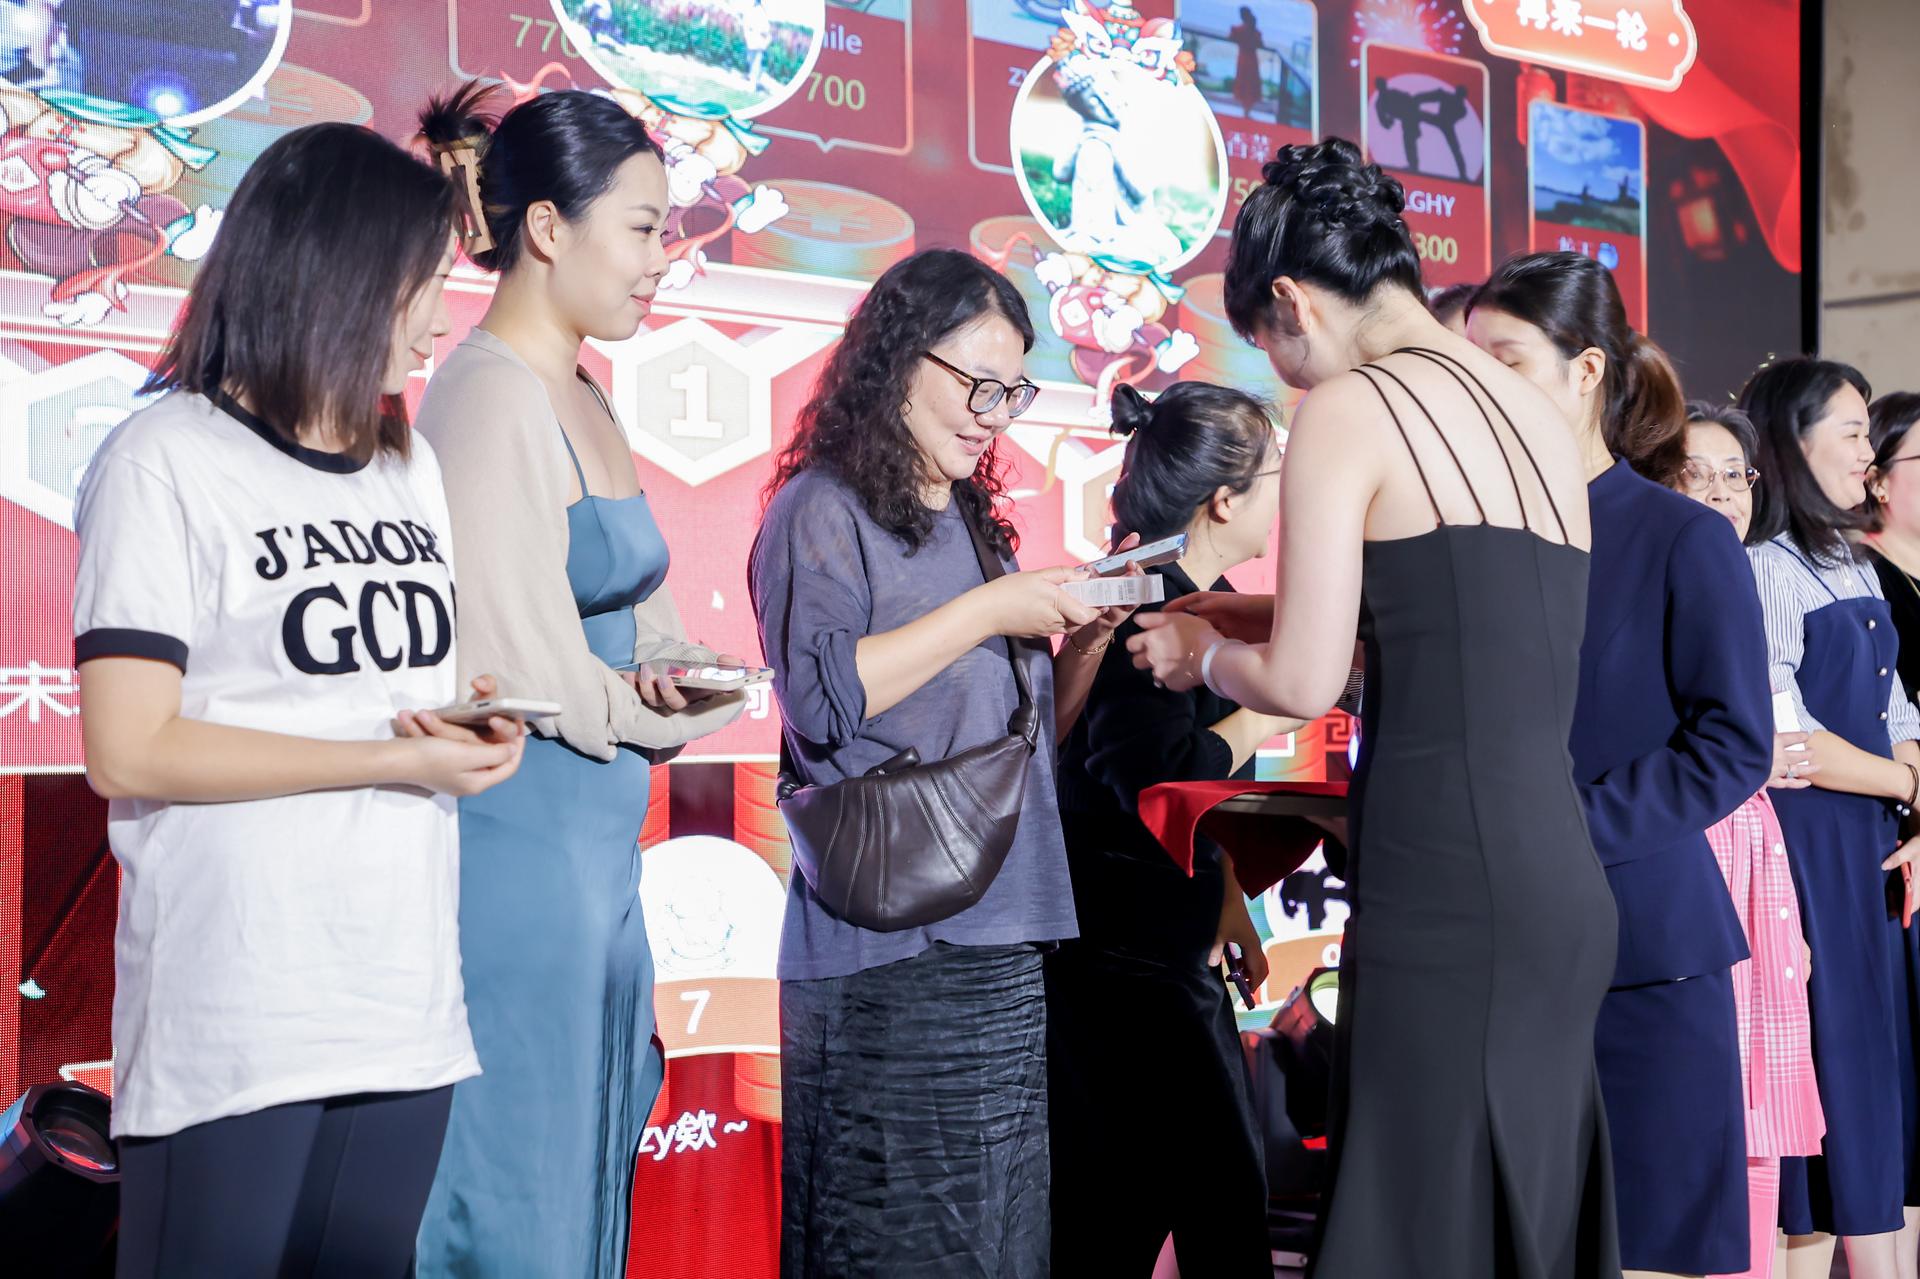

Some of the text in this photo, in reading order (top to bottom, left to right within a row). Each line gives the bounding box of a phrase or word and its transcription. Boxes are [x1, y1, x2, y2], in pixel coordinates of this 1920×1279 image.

[1516, 0, 1648, 51] 再来一轮
[807, 71, 866, 111] 700
[669, 363, 723, 439] 1
[255, 519, 448, 580] J'ADOR
[282, 581, 457, 675] GCD
[0, 660, 80, 722] 宋
[681, 990, 711, 1034] 7
